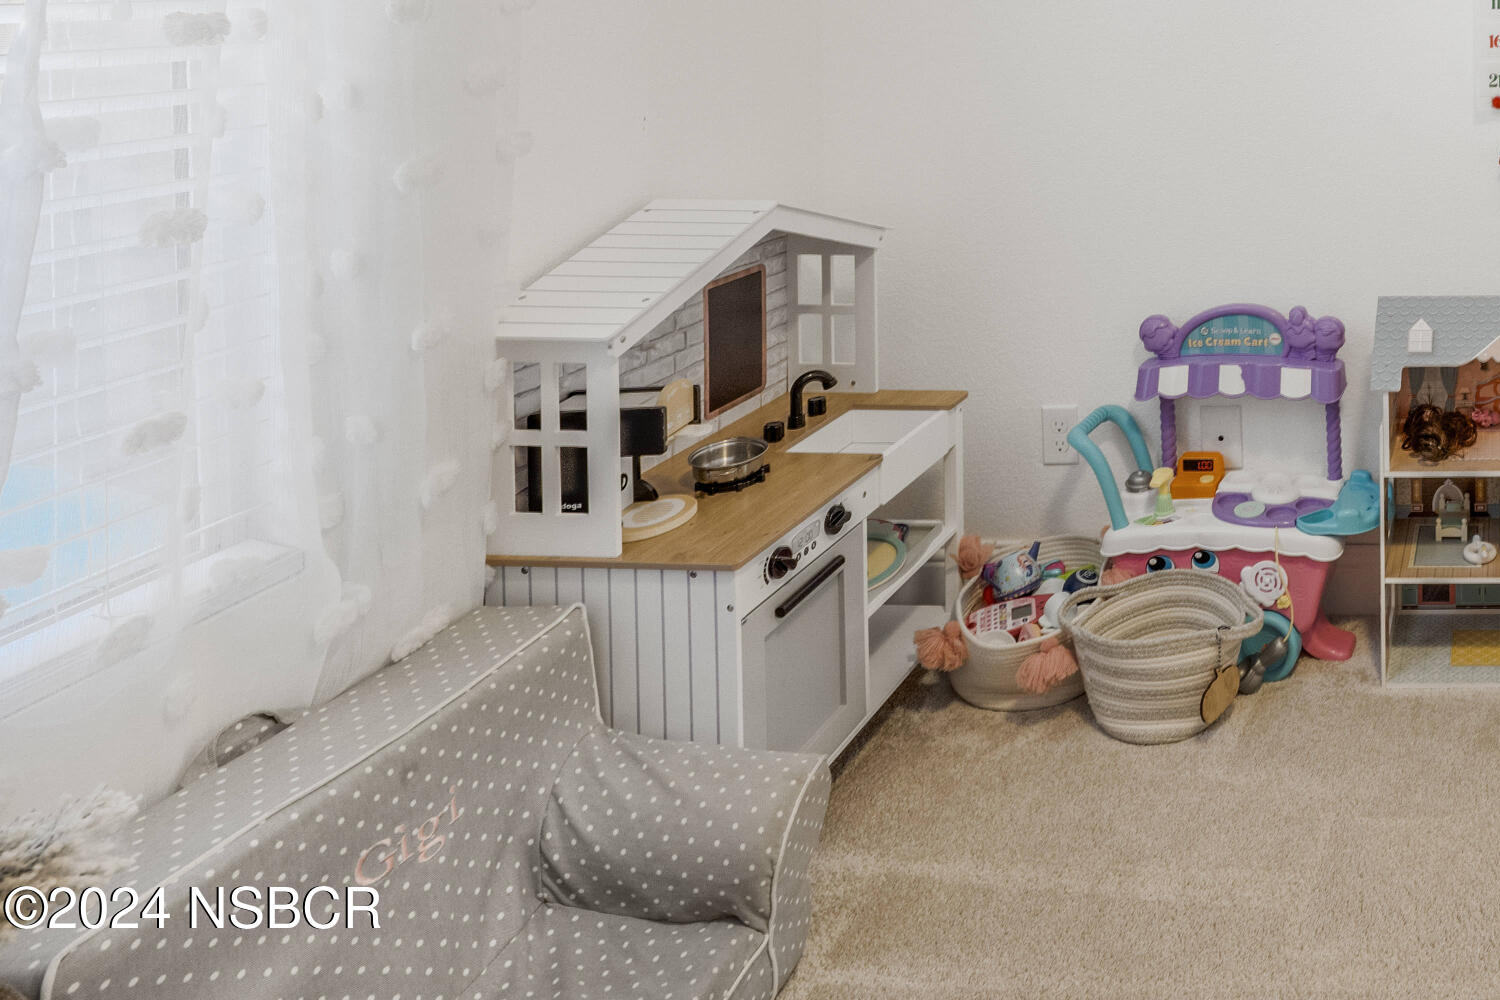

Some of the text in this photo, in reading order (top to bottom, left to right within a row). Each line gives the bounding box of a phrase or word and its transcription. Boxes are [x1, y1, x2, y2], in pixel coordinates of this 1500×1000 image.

[1188, 336, 1269, 348] Ice Cream Cart
[355, 785, 464, 886] Gigi
